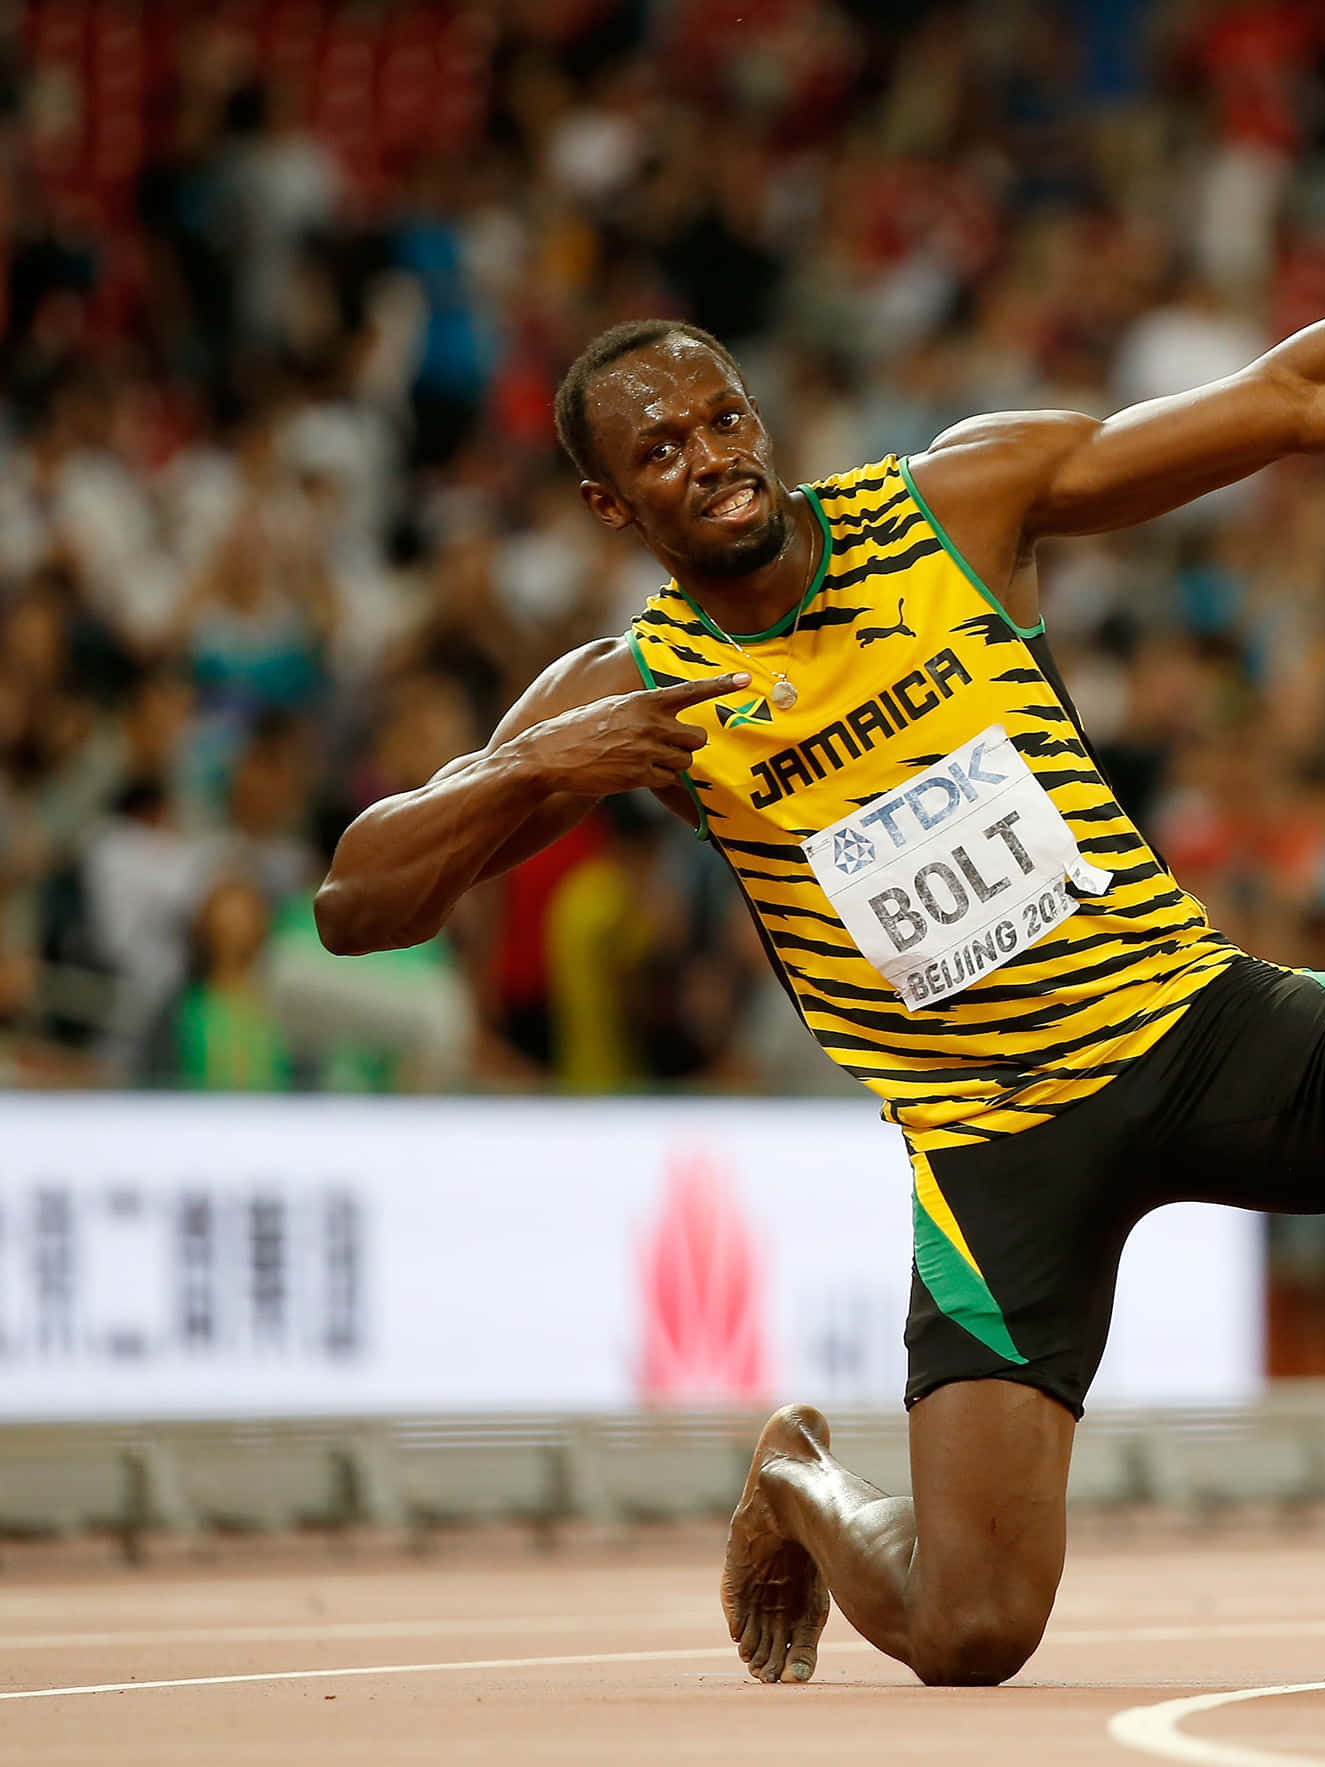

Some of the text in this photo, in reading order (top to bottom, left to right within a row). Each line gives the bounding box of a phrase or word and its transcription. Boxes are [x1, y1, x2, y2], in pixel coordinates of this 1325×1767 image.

[750, 647, 973, 810] JAMAICA
[859, 743, 1009, 848] TDK
[868, 810, 1036, 952] BOLT
[906, 920, 1017, 1001] BEIJING
